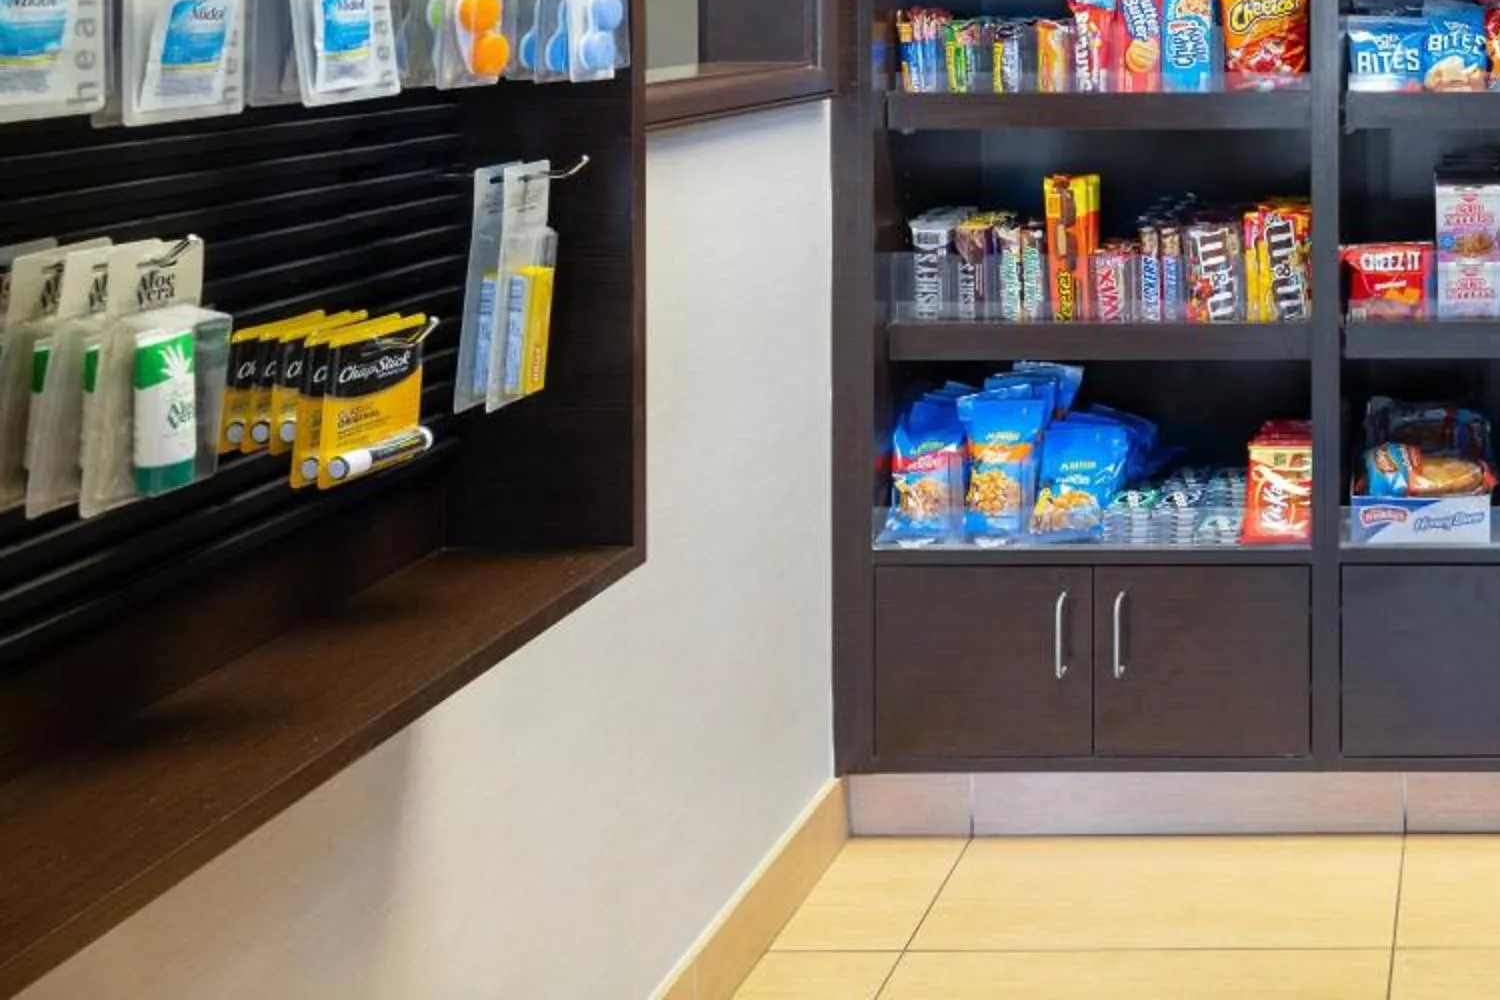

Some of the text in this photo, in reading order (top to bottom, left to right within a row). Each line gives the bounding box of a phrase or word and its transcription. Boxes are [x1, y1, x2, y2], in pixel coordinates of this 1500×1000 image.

[1427, 31, 1486, 57] BITES
[1357, 46, 1420, 74] BITES
[138, 270, 175, 290] Aloe
[913, 252, 939, 322] ERSHEY'S
[137, 287, 175, 306] Vera
[339, 350, 411, 384] ChapStick
